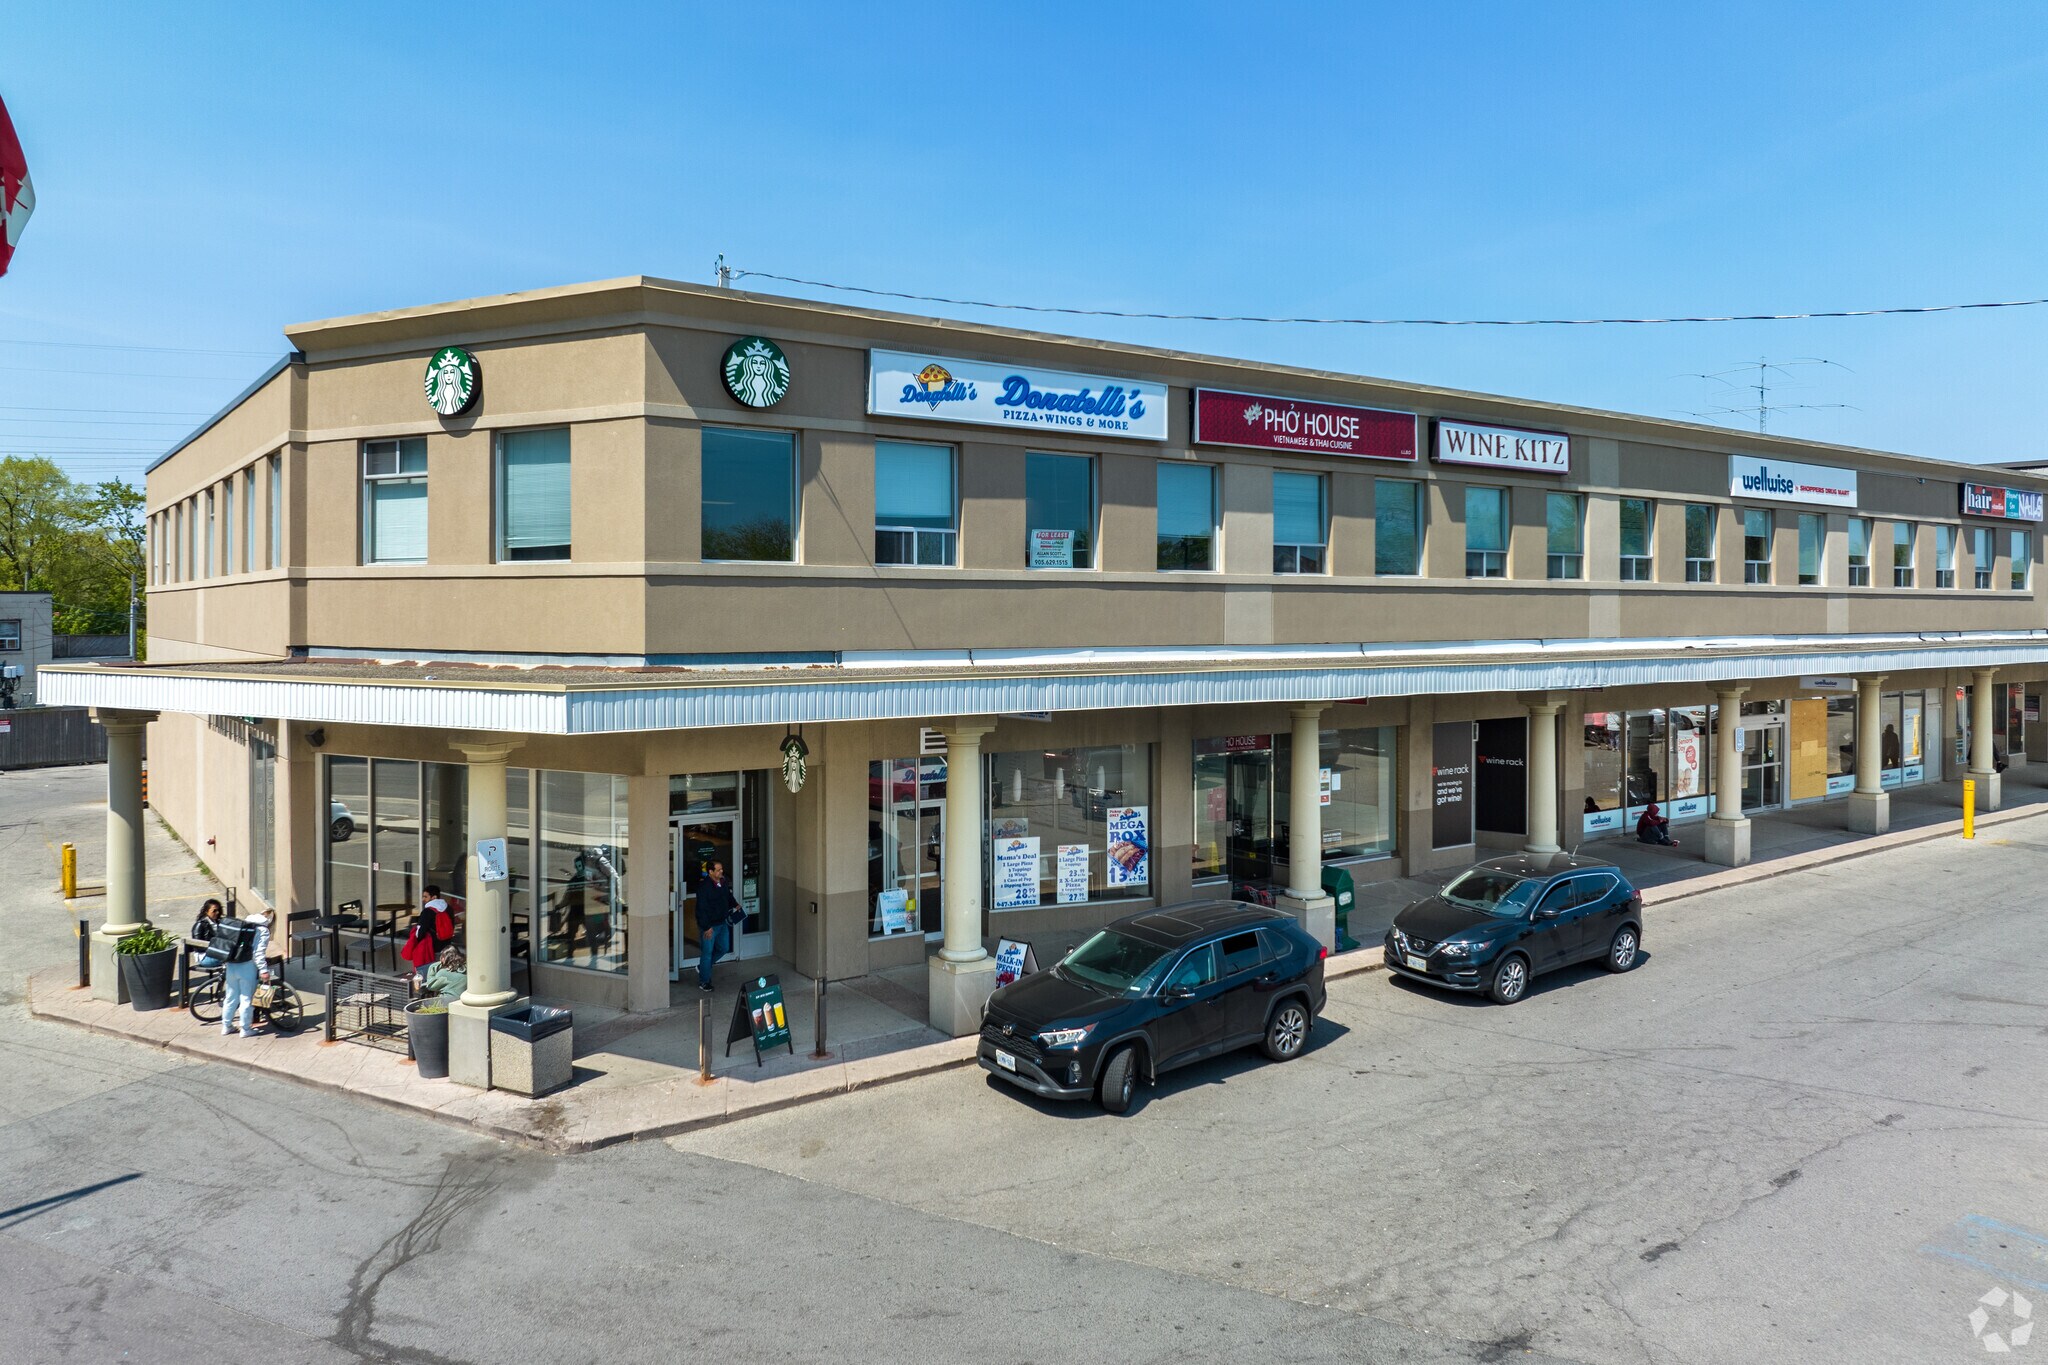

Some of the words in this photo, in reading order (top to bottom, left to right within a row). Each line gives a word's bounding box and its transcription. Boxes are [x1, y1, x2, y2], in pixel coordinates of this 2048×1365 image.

[995, 375, 1146, 420] Donatelli's
[1086, 418, 1095, 427] &
[1098, 418, 1129, 431] MORE
[1304, 412, 1360, 439] HOUSE
[1273, 435, 1308, 446] VIETNAMESE
[1314, 439, 1329, 448] THAI
[1330, 440, 1353, 450] CUISINE
[1446, 429, 1509, 459] WINE
[1515, 438, 1564, 465] KITZ
[1742, 466, 1794, 494] wellwise
[1800, 485, 1825, 494] SHOPPERS
[1968, 486, 1992, 510] hair
[1235, 735, 1256, 746] HOUSE
[1486, 756, 1505, 765] wine
[1506, 758, 1524, 767] rack
[1437, 766, 1454, 776] wine
[1454, 763, 1470, 774] rack
[1436, 787, 1448, 796] and
[1436, 796, 1447, 806] got
[1109, 820, 1145, 830] MEGA
[1109, 829, 1146, 843] BOX
[1069, 869, 1078, 877] 23
[1133, 865, 1145, 875] 95
[1015, 888, 1028, 899] 28
[1068, 893, 1078, 901] 27
[997, 954, 1024, 967] WALK-IN
